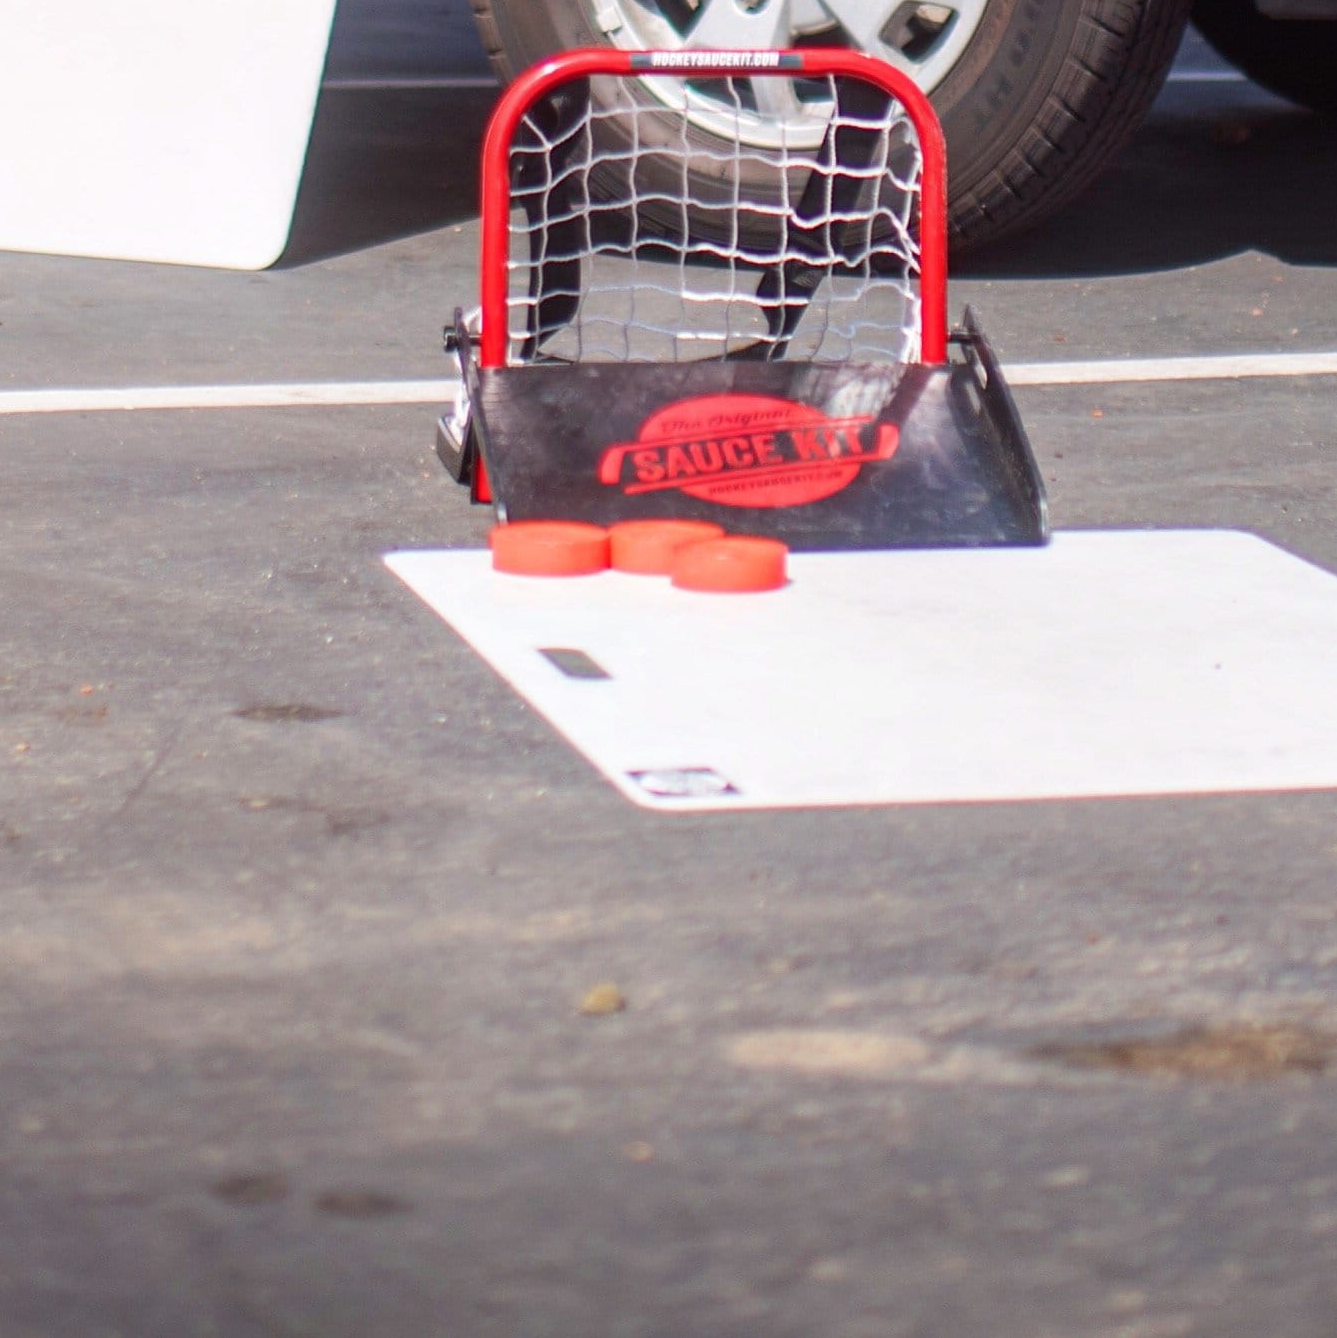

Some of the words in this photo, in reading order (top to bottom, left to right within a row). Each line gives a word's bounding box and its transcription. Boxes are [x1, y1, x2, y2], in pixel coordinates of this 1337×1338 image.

[651, 51, 780, 67] HOCKEYSAUCEKIT.COM
[631, 432, 783, 483] SAUCE
[790, 426, 863, 462] KIT
